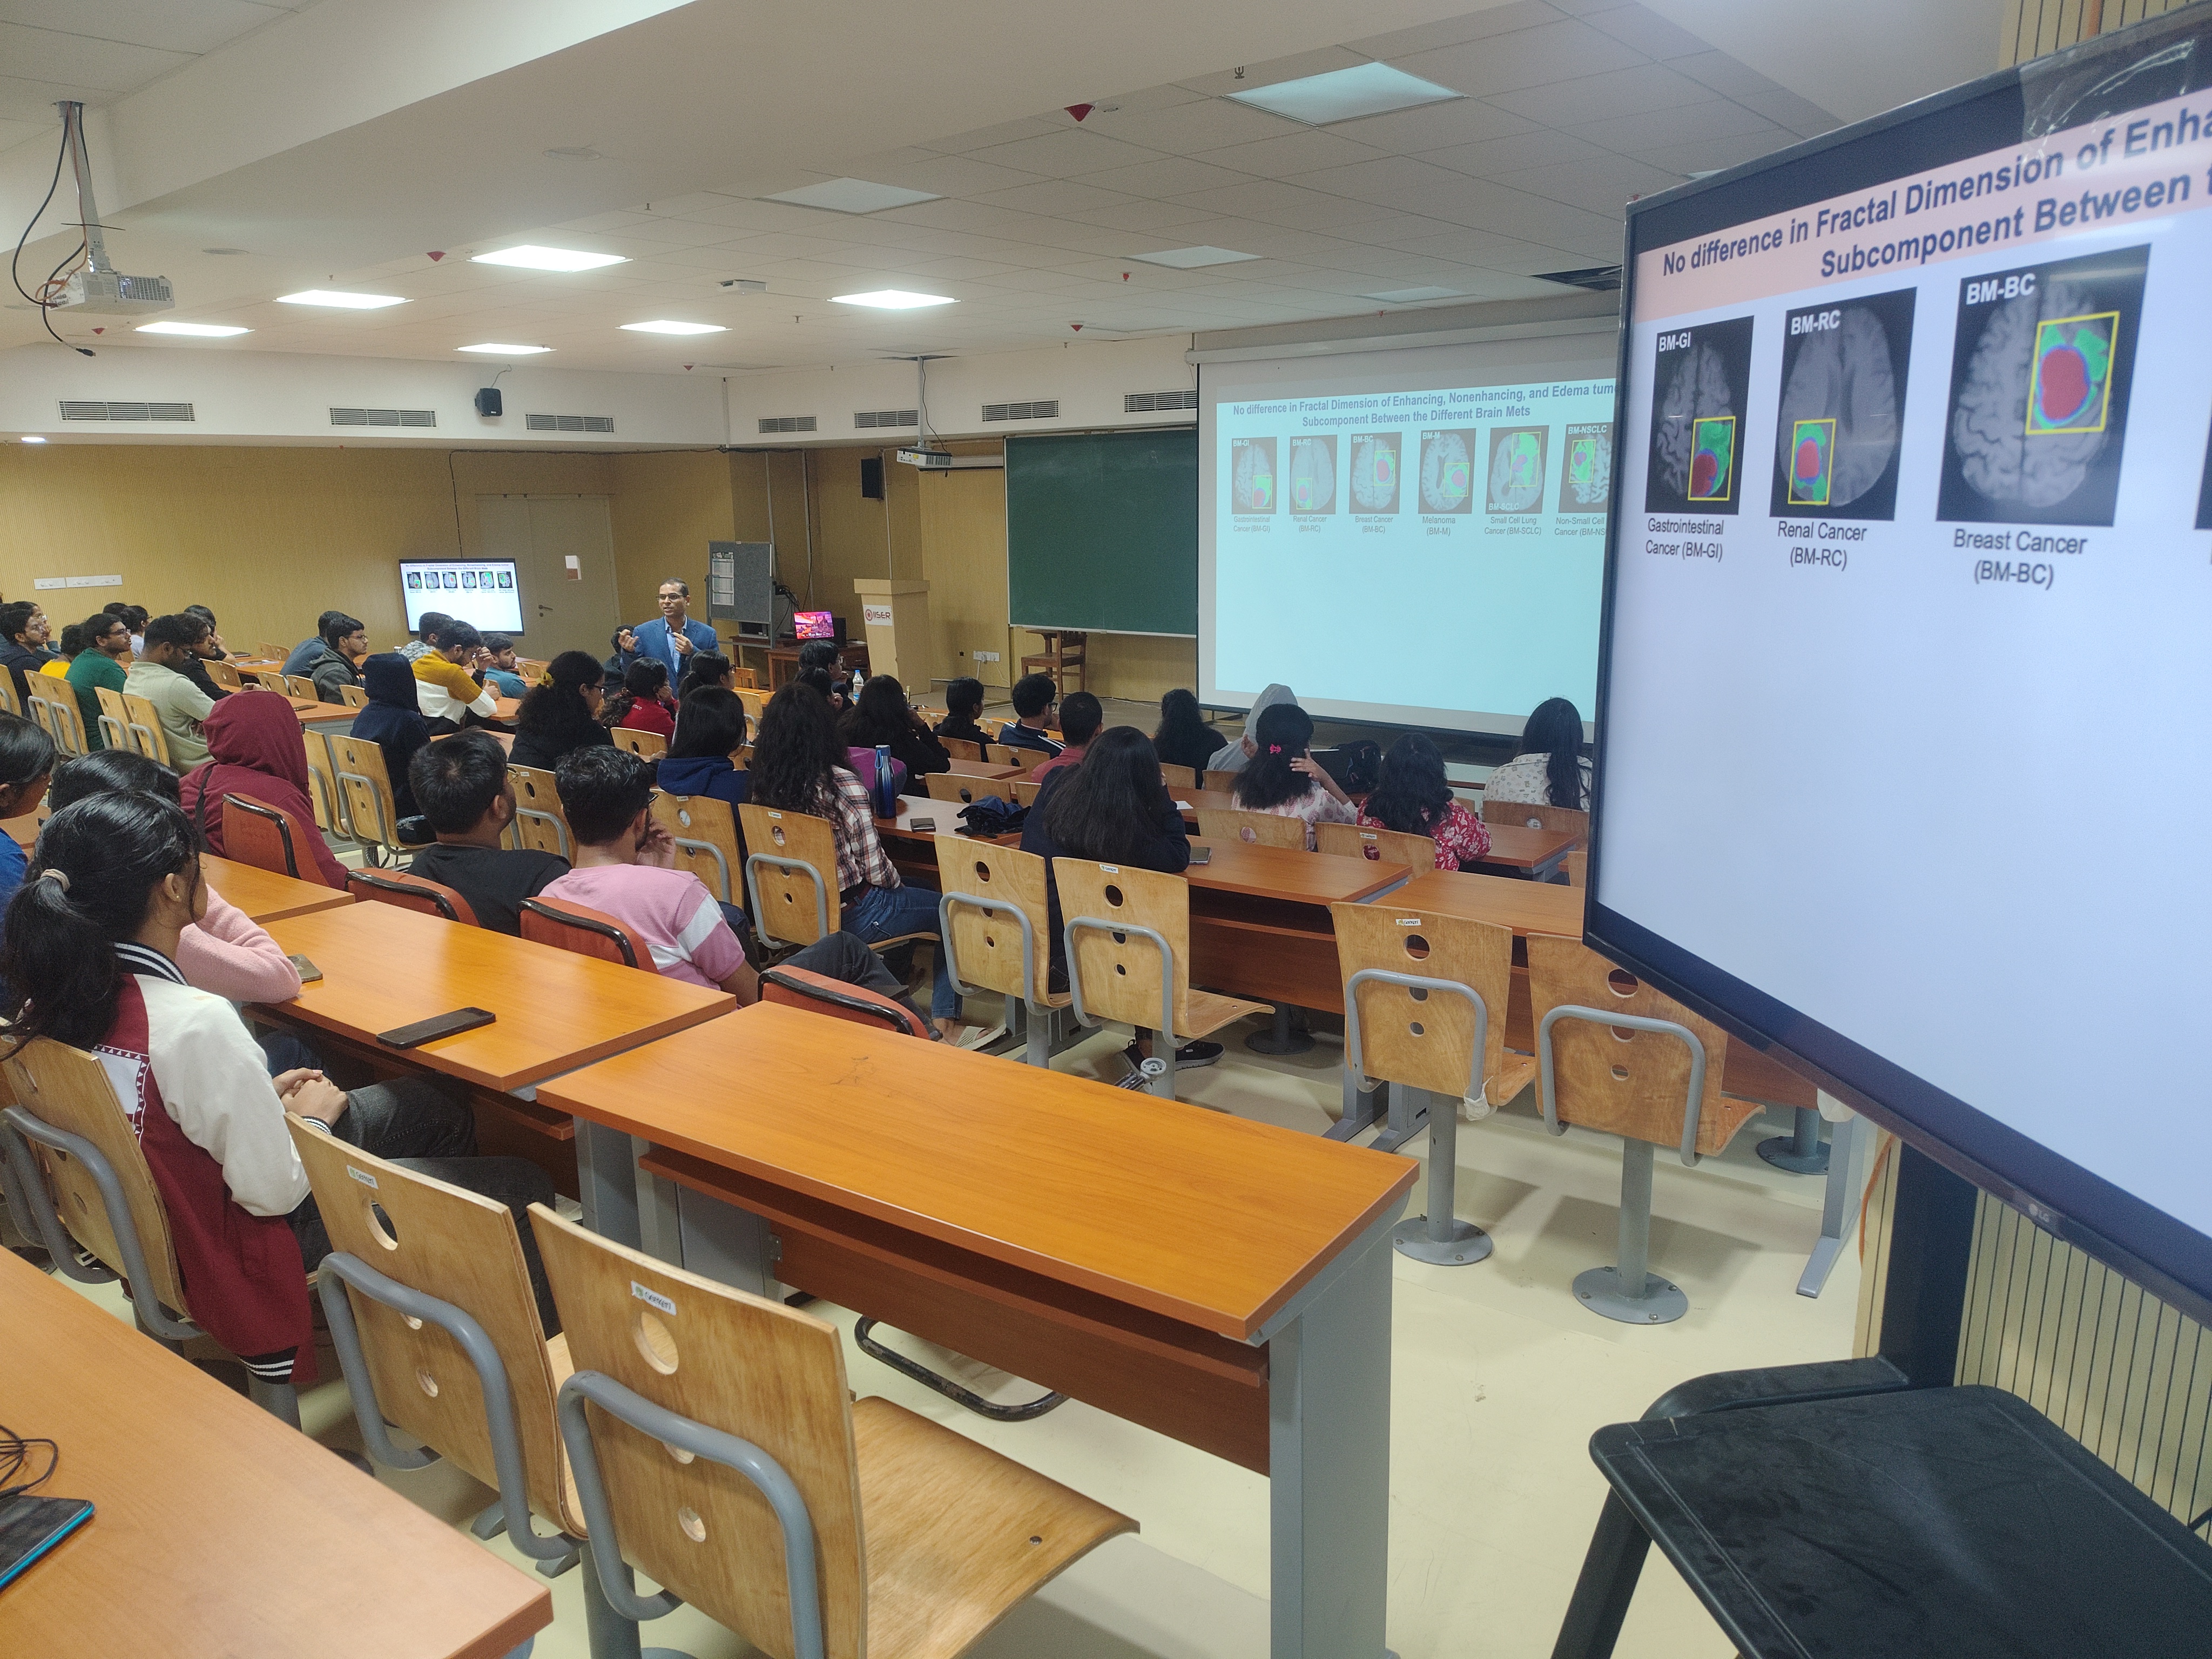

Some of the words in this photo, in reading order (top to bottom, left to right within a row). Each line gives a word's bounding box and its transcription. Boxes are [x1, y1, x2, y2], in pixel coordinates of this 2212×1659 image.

[1663, 252, 1685, 276] No
[1691, 228, 1783, 268] difference
[1790, 218, 1808, 245] in
[1816, 191, 1896, 238] Fractal
[1905, 152, 2063, 215] Dimension
[2076, 128, 2115, 170] of
[1820, 205, 2023, 278] Subcomponent
[2034, 173, 2191, 233] Between
[1966, 273, 2035, 305] BM-BC
[1791, 310, 1841, 335] BM-RC
[1658, 332, 1691, 352] BM-GI
[1233, 405, 1244, 415] No
[1247, 403, 1287, 415] difference
[1290, 402, 1297, 412] in
[1300, 400, 1328, 411] Fractal
[1331, 398, 1378, 410] Dimension
[1381, 396, 1391, 407] of
[1393, 394, 1446, 406] Enhancing,
[1449, 389, 1526, 403] Nonenhancing,
[1529, 386, 1549, 399] and
[1552, 385, 1589, 397] Edema
[1593, 383, 1616, 395] tum
[1303, 414, 1368, 427] Subcomponent
[1372, 413, 1410, 423] Between
[1413, 411, 1427, 421] the
[1431, 408, 1473, 420] Different
[1475, 408, 1502, 418] Brain
[1506, 406, 1530, 417] Mets
[1353, 435, 1373, 443] BM-BC
[1422, 431, 1440, 440] BM-M
[1568, 426, 1607, 435] BM-NSCLC
[1299, 525, 1320, 533] (BM-RC)
[1522, 517, 1537, 525] Lung
[1648, 518, 1724, 535] Gastrointestinal
[1778, 521, 1813, 538] Renal
[1818, 522, 1867, 541] Cancer
[1426, 527, 1451, 536] (BM-M)
[1485, 527, 1506, 535] Cancer
[1507, 527, 1542, 536] (BM-SCLC)
[1554, 528, 1579, 536] Cancer
[1954, 528, 2011, 550] Breast
[2016, 531, 2088, 555] Cancer
[1645, 540, 1680, 556] Cancer
[1682, 541, 1723, 563] (BM-GI)
[1790, 547, 1847, 571] (BM-RC)
[1974, 559, 2054, 590] (BM-BC)
[873, 611, 891, 619] IISER
